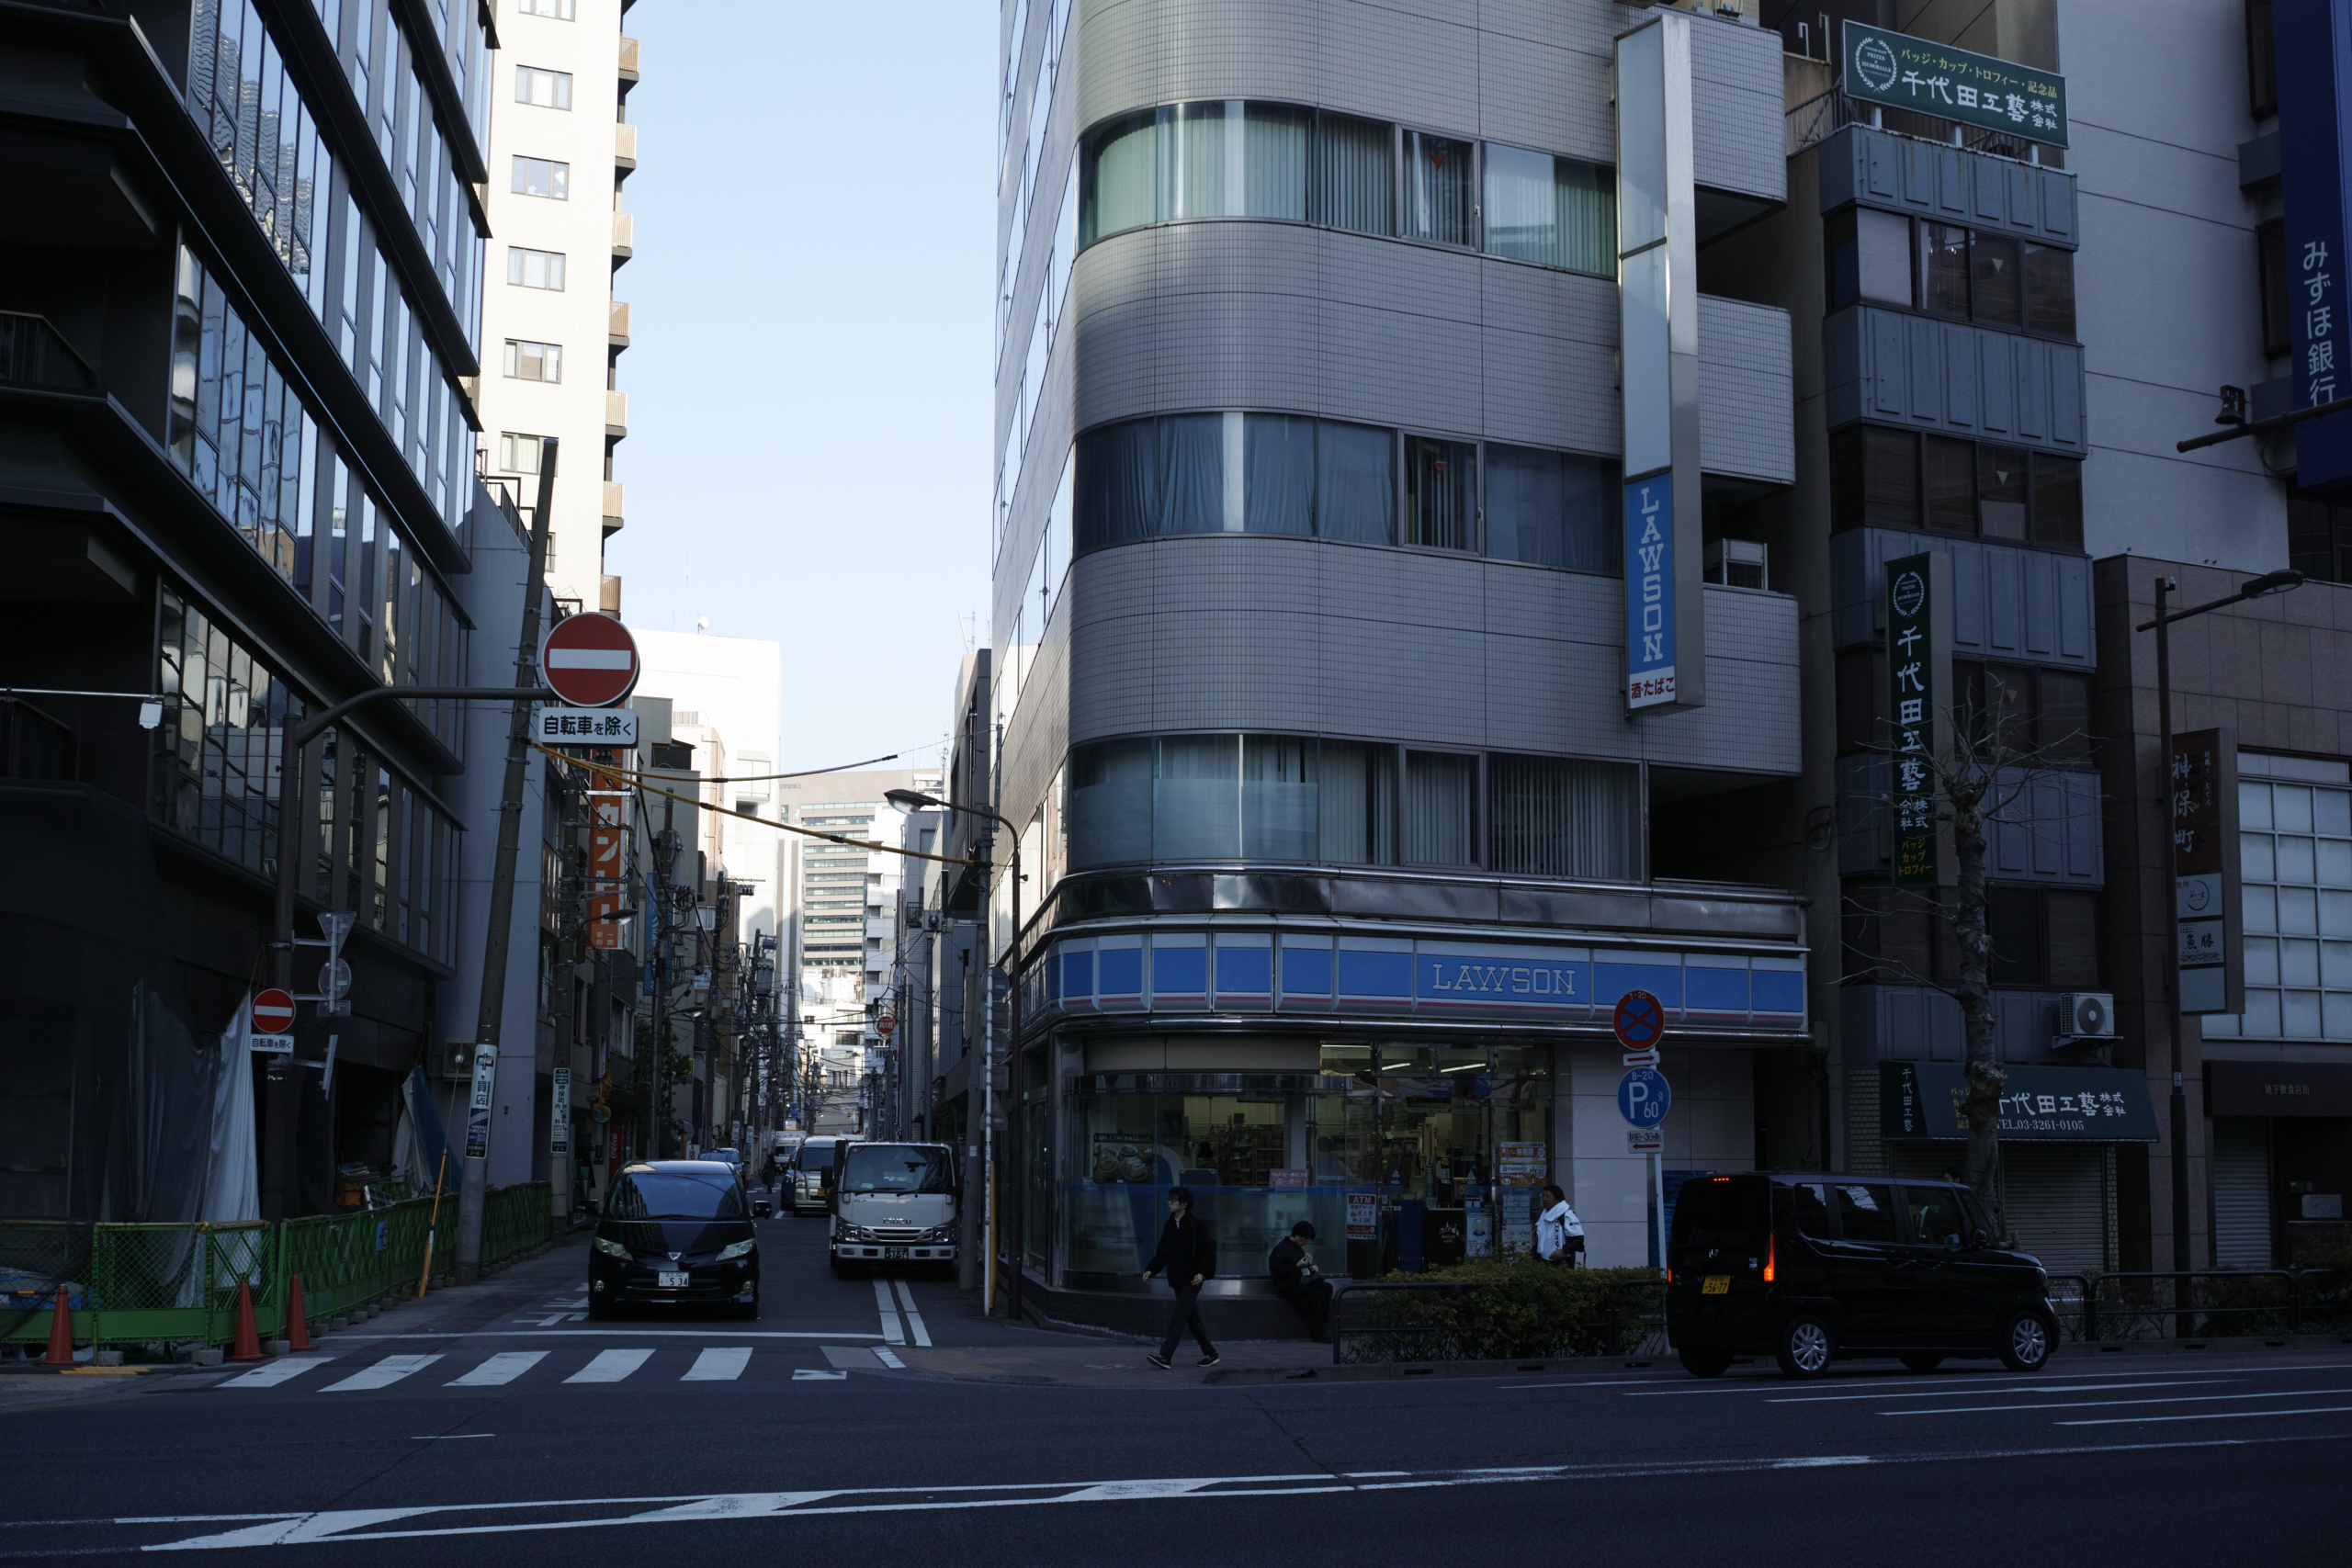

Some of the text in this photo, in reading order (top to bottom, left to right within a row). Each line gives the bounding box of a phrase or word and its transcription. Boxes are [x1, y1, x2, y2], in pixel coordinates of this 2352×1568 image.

[1867, 51, 1885, 62] PRIZES
[2302, 241, 2335, 407] みずほ銀行
[1638, 487, 1664, 662] LAWSON
[544, 715, 631, 736] 自転車を除く
[1898, 864, 1933, 876] トロフィー
[1431, 963, 1576, 997] LAWSON
[1629, 991, 1646, 999] 7-20
[252, 1038, 291, 1049] 自転車を除く
[1632, 1070, 1654, 1081] 8-20
[2264, 1084, 2310, 1096] 地下飲食店街
[1628, 1081, 1649, 1120] P
[1644, 1101, 1659, 1119] 60
[1352, 1196, 1372, 1204] ATM
[889, 1251, 909, 1259] 97-56
[1707, 1282, 1727, 1292] 56-77
